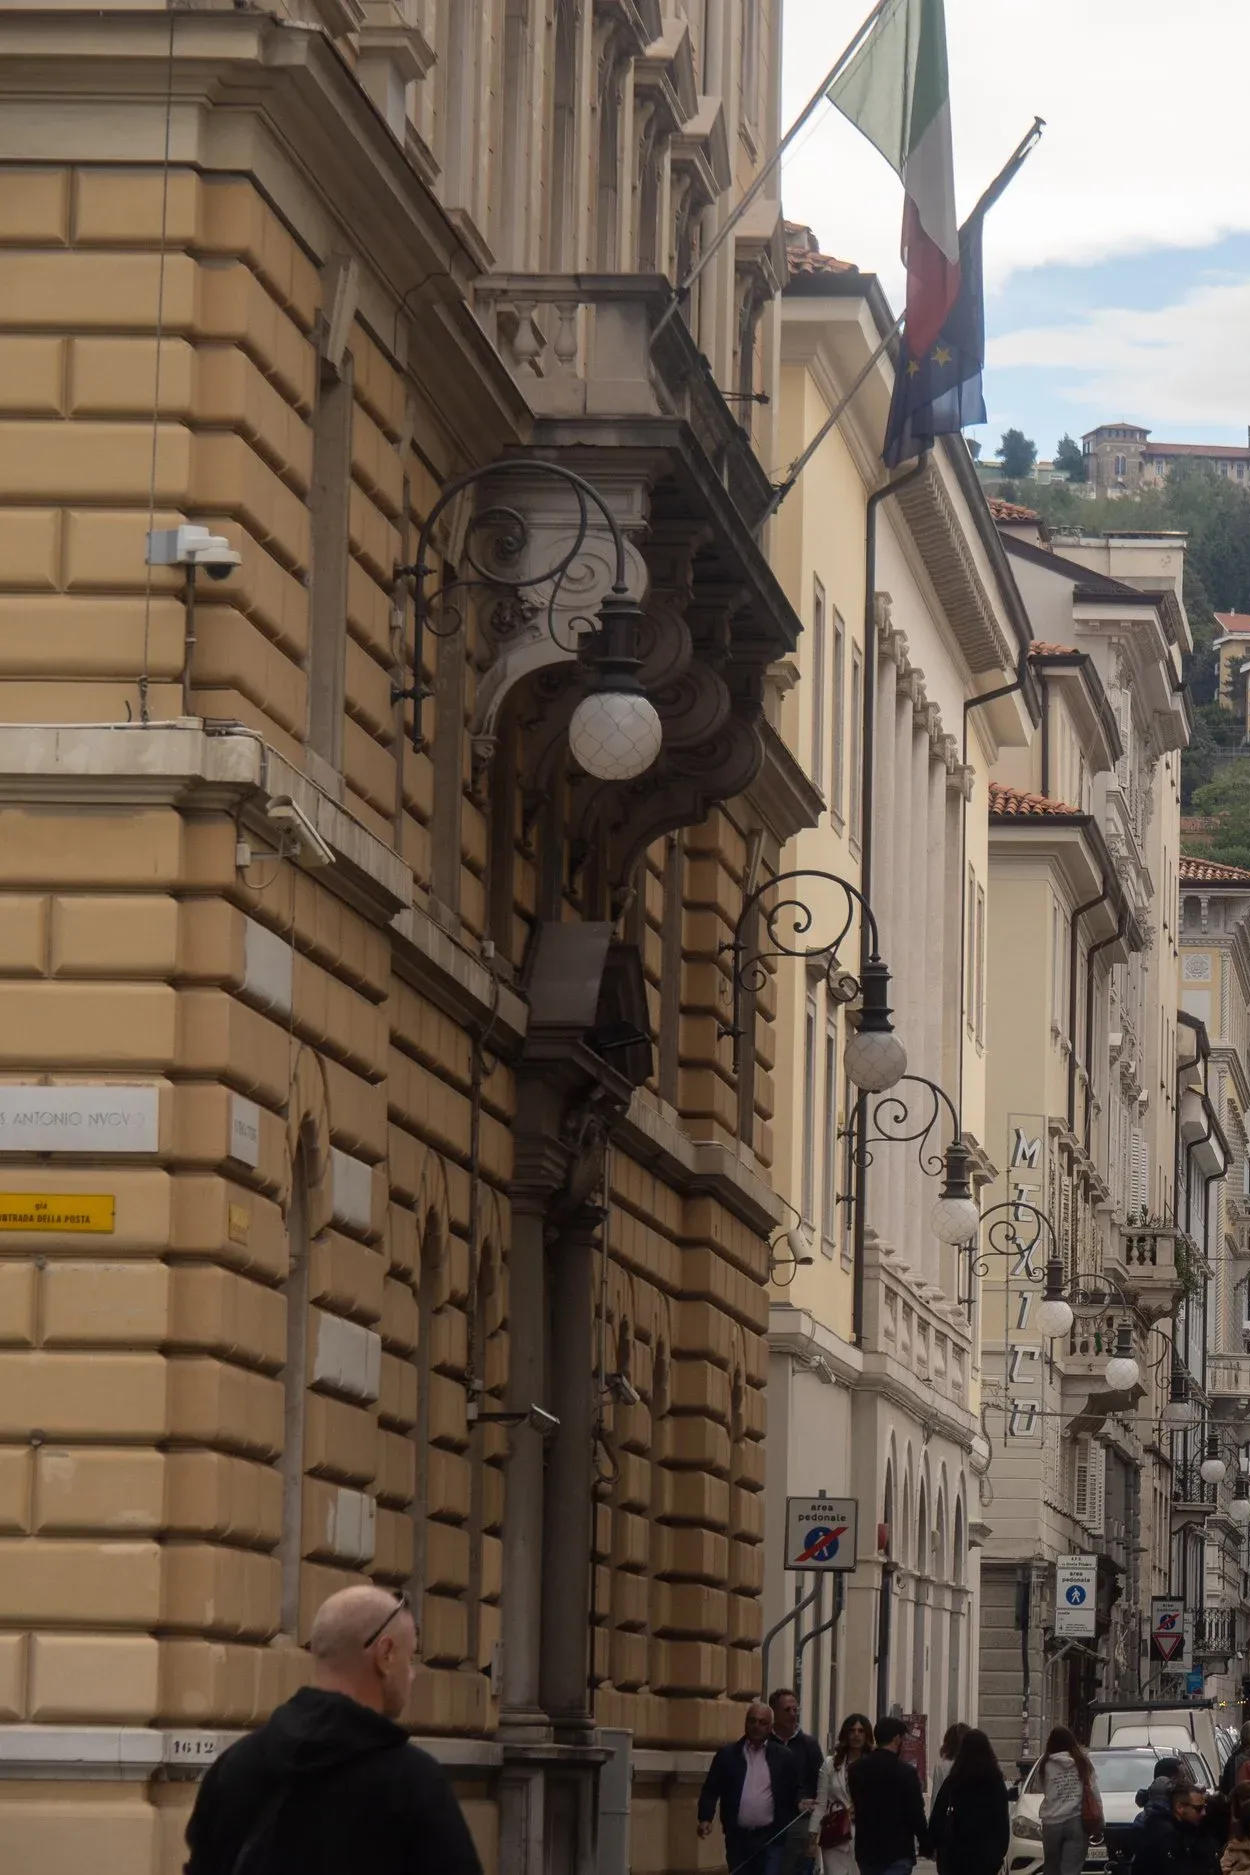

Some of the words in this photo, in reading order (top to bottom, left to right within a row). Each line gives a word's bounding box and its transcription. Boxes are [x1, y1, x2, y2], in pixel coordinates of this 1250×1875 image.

[12, 1111, 82, 1126] ANTONIO
[0, 1212, 35, 1224] NTRADA
[37, 1213, 61, 1224] DELLA
[64, 1214, 91, 1225] POSTA
[1009, 1126, 1042, 1438] MEXICO
[810, 1504, 834, 1512] area
[798, 1513, 847, 1522] pedonale
[174, 1740, 214, 1755] 1612
